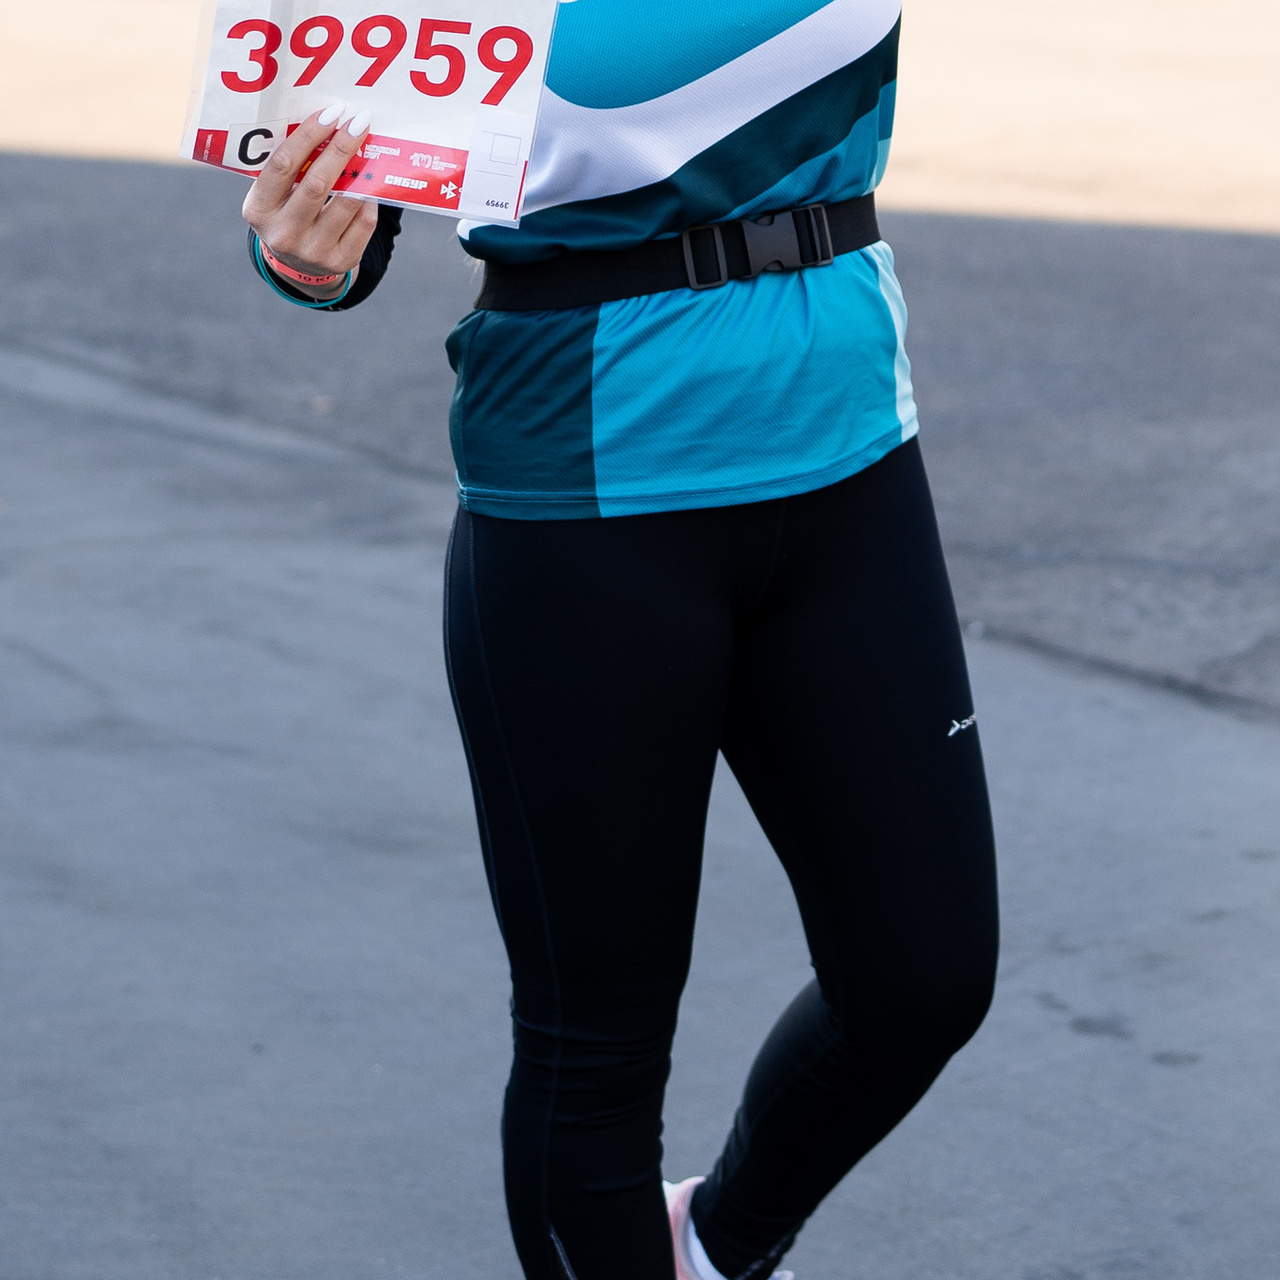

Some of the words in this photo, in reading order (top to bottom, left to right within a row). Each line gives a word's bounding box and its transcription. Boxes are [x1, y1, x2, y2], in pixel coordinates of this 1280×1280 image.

[220, 14, 534, 106] 39959
[384, 174, 428, 190] СИБУР
[485, 200, 509, 209] 39959
